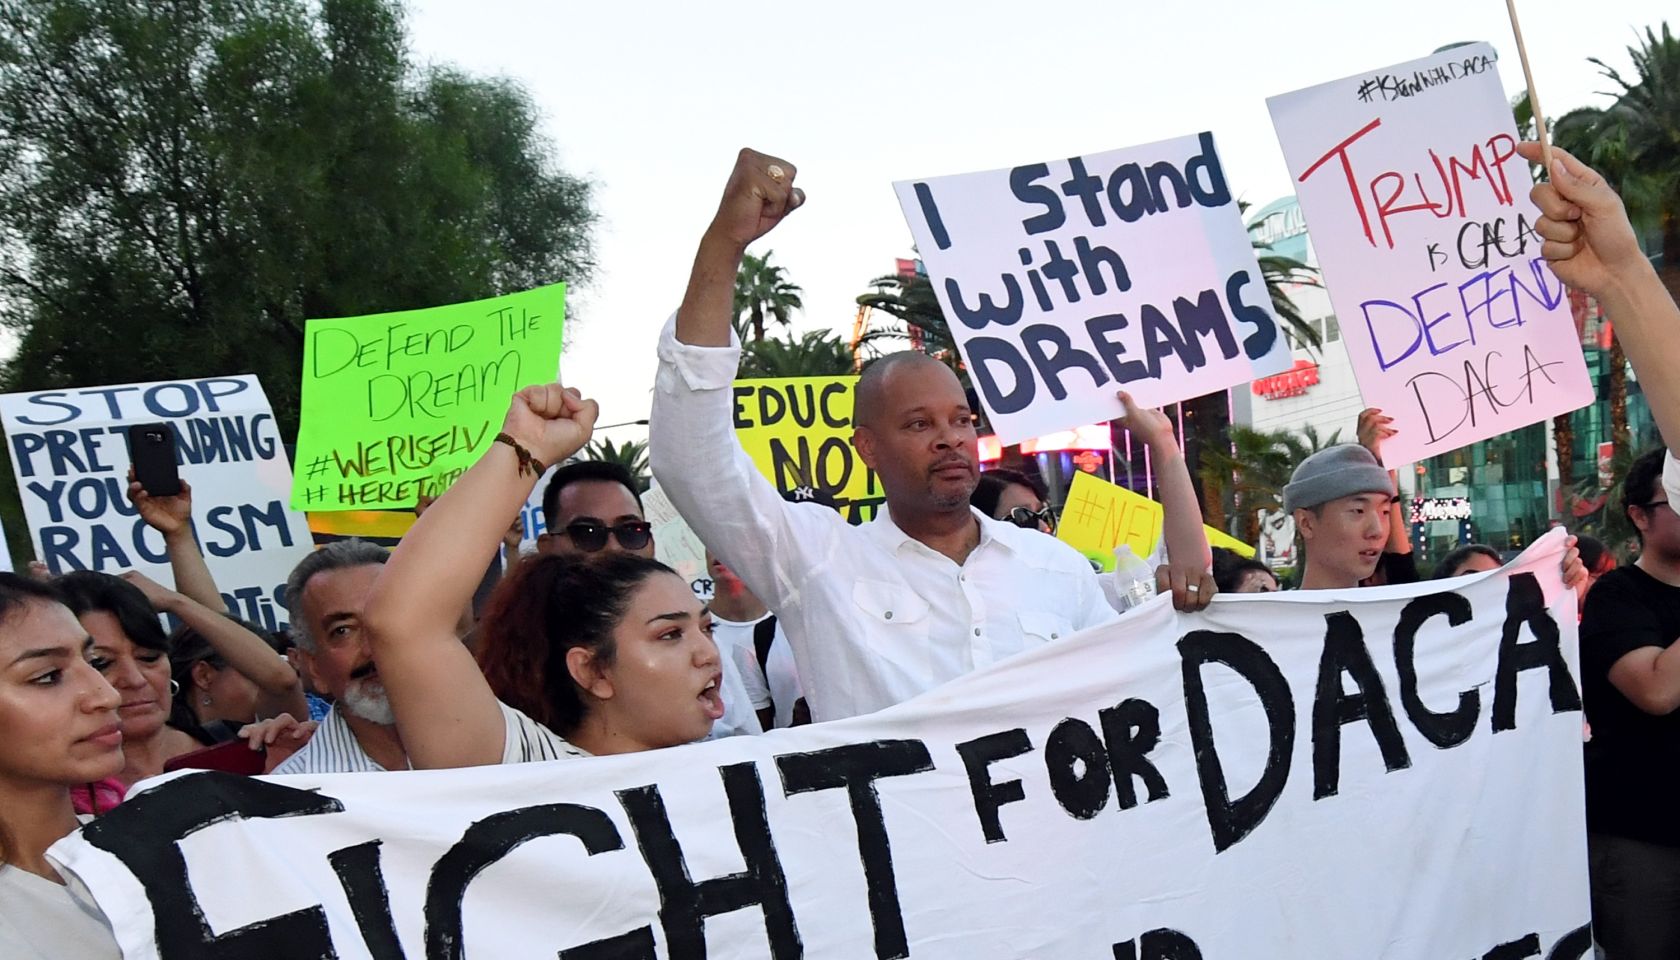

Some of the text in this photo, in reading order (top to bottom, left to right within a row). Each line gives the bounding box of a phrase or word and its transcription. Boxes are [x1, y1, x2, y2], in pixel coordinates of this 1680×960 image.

[913, 182, 951, 250] I
[1009, 131, 1232, 236] Stand
[1298, 117, 1518, 250] TRUMP
[945, 236, 1132, 330] with
[1456, 213, 1542, 270] CACA
[963, 270, 1278, 415] DREAMS
[1359, 254, 1564, 372] DEFEND
[15, 378, 249, 426] STOP
[367, 349, 522, 422] DREAM
[732, 382, 857, 429] EDUC
[1405, 344, 1566, 446] DACA
[11, 413, 276, 477] PRETNDING
[39, 500, 294, 574] RACSM
[82, 572, 1582, 960] FIGHT FOR DACA
